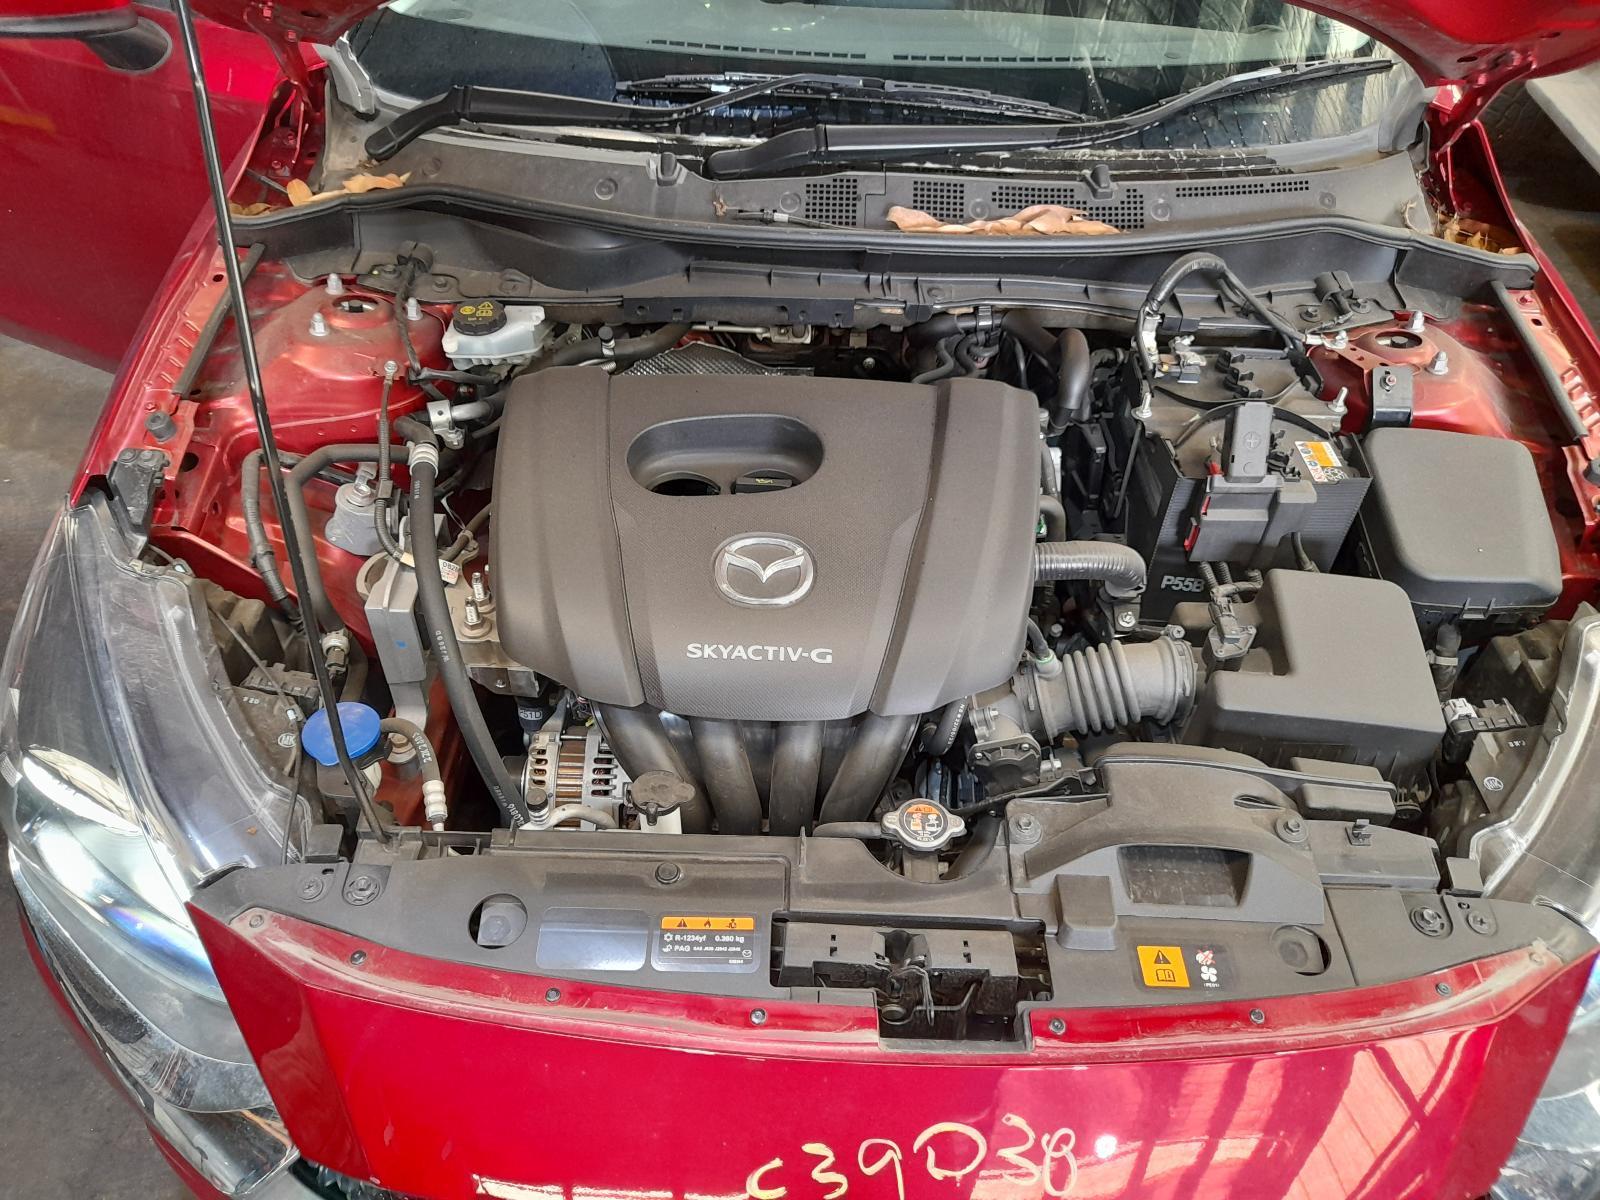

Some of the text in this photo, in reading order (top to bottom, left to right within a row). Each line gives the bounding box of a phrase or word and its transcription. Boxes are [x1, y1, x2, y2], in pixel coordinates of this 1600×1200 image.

[1161, 575, 1206, 592] P55B
[686, 642, 833, 664] SKYACTIV-G
[674, 934, 707, 943] R-1234yf
